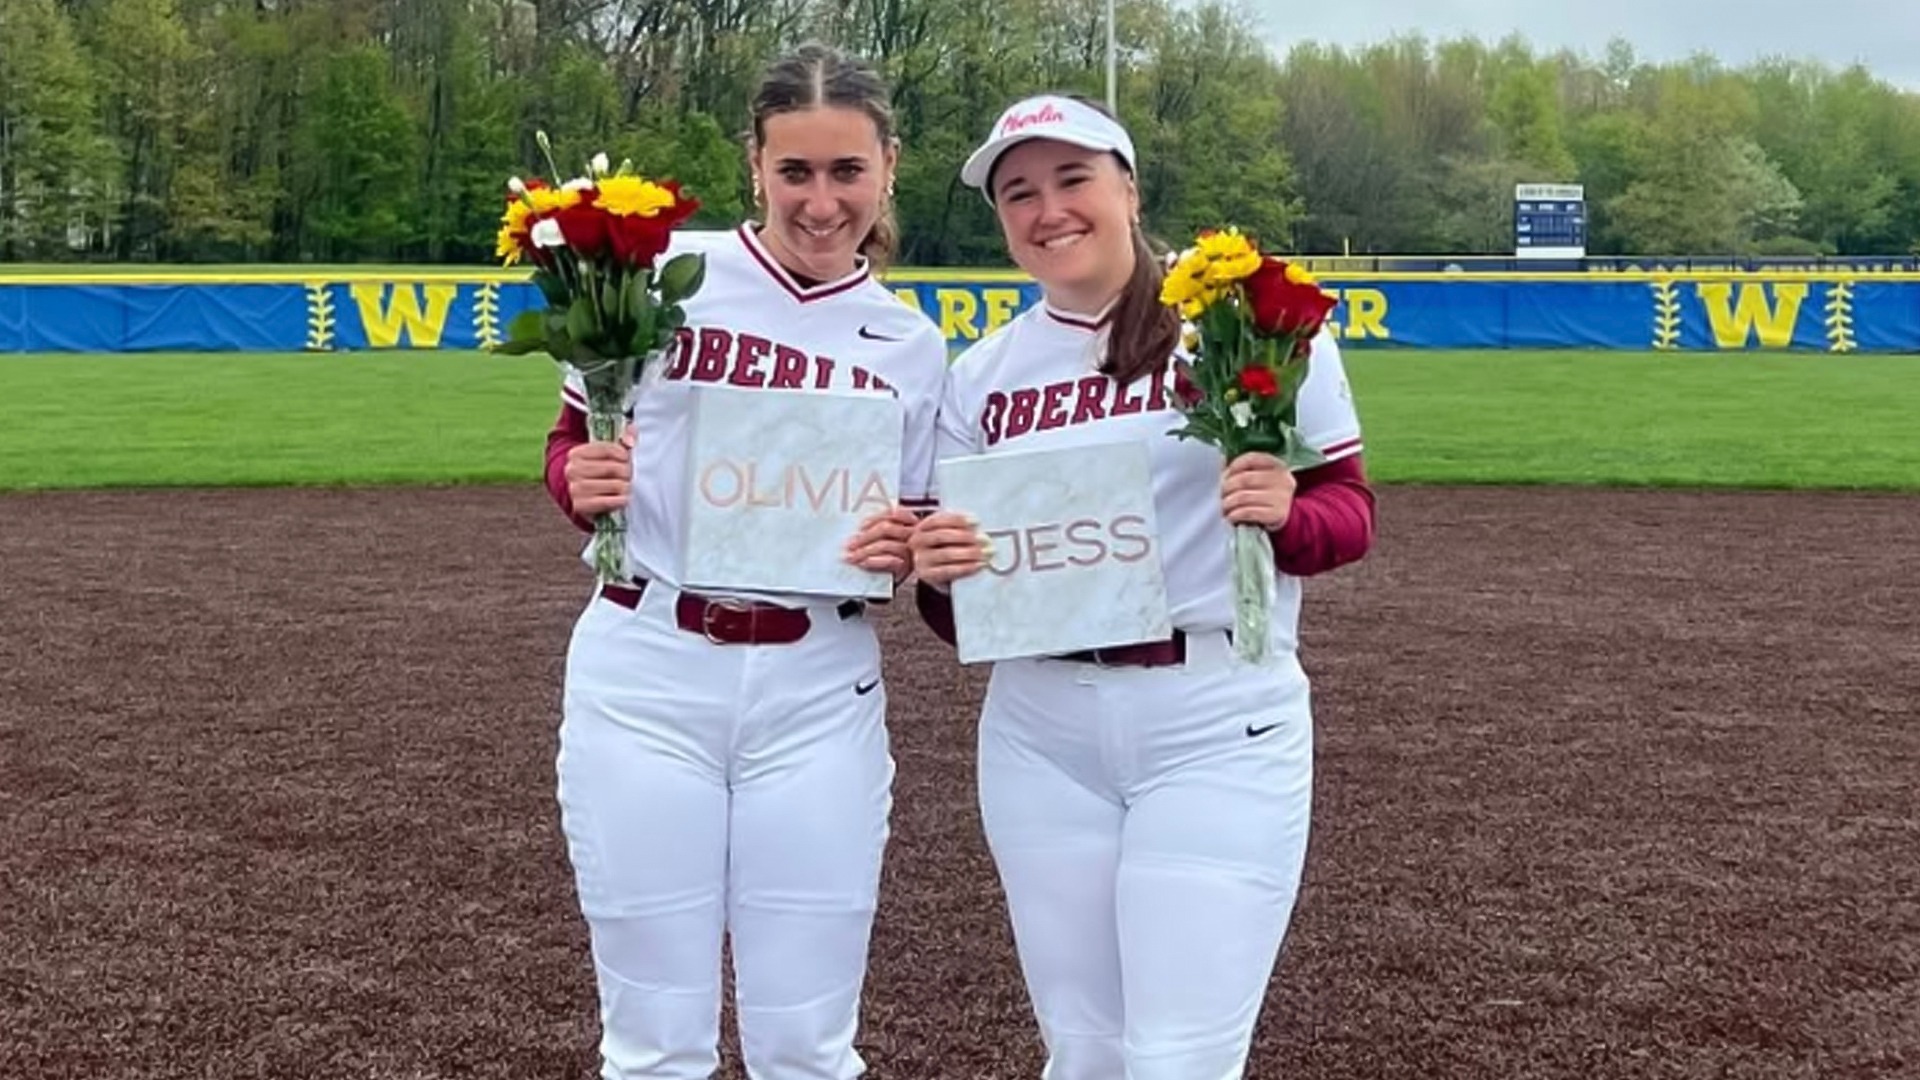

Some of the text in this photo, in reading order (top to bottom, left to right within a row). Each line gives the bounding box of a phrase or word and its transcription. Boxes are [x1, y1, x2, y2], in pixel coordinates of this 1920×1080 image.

[351, 282, 457, 347] W
[1697, 282, 1808, 347] W
[700, 457, 896, 514] OLIVIA
[984, 515, 1151, 576] JESS
